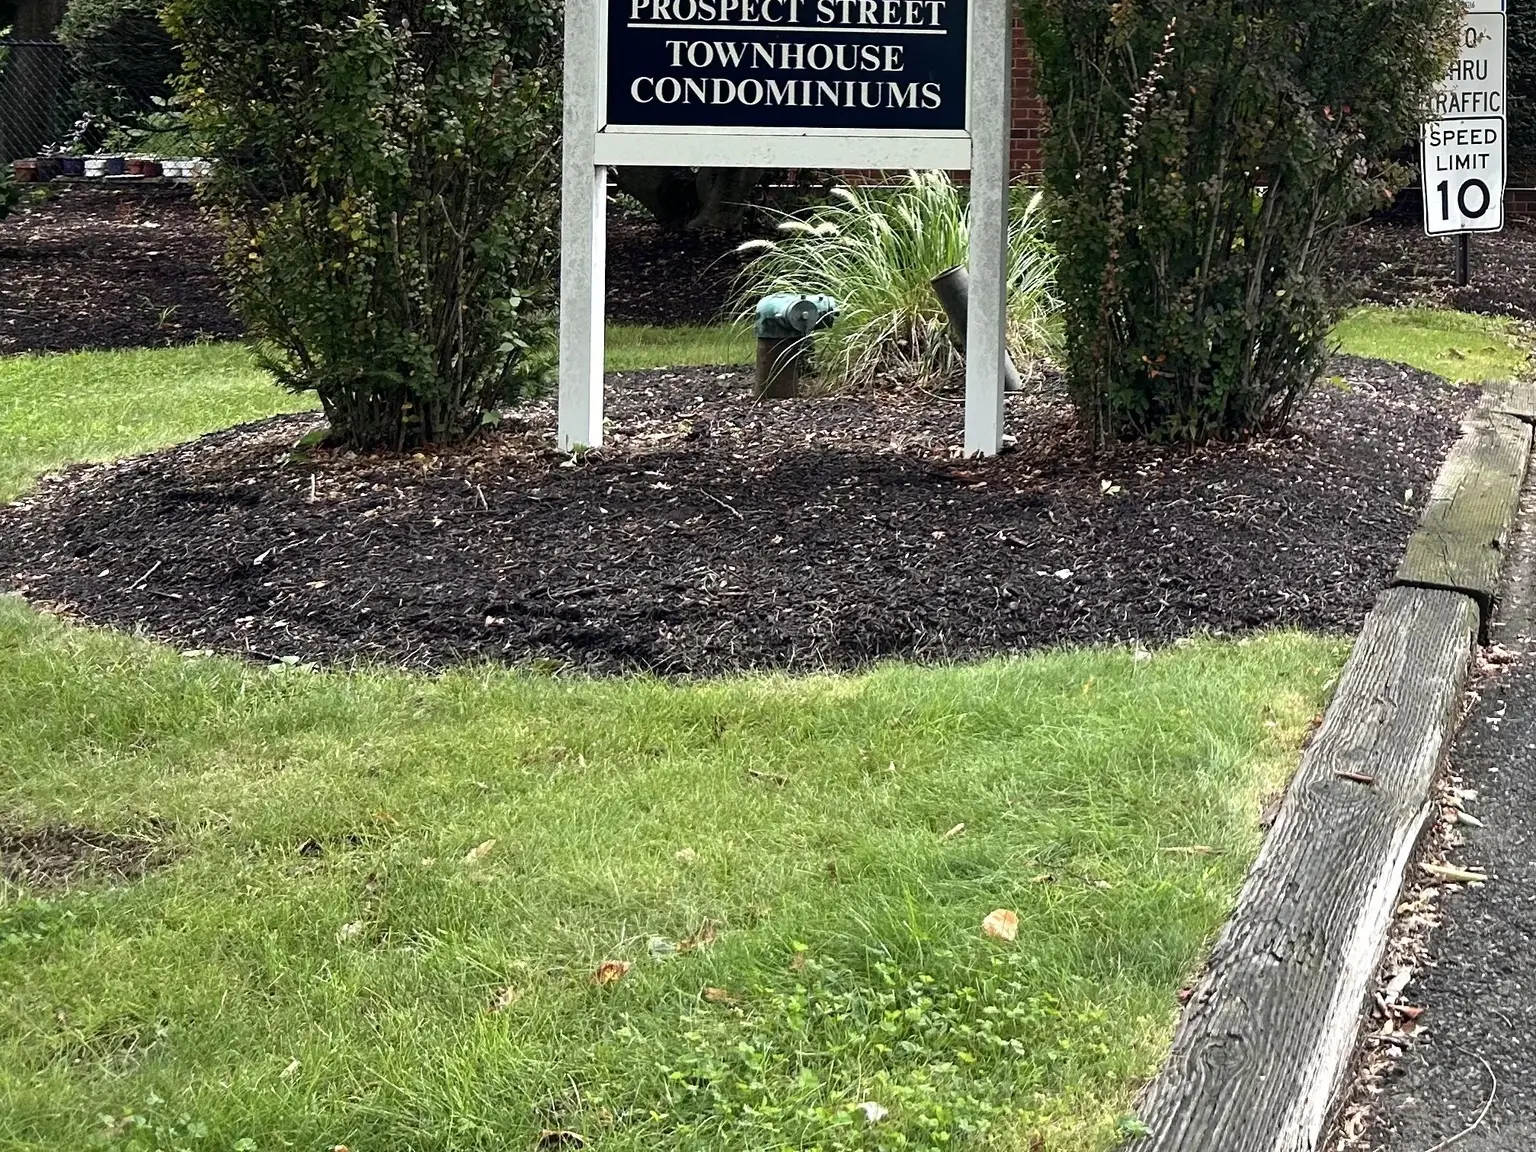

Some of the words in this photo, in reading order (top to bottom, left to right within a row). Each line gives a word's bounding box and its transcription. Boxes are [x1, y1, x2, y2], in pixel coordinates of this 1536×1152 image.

[666, 40, 904, 72] TOWNHOUSE
[1449, 59, 1488, 81] HRU
[630, 76, 942, 110] CONDOMINIUMS
[1436, 91, 1501, 113] RAFFIC
[1430, 129, 1497, 146] SPEED
[1437, 154, 1489, 171] LIMIT
[1437, 178, 1490, 220] 10
